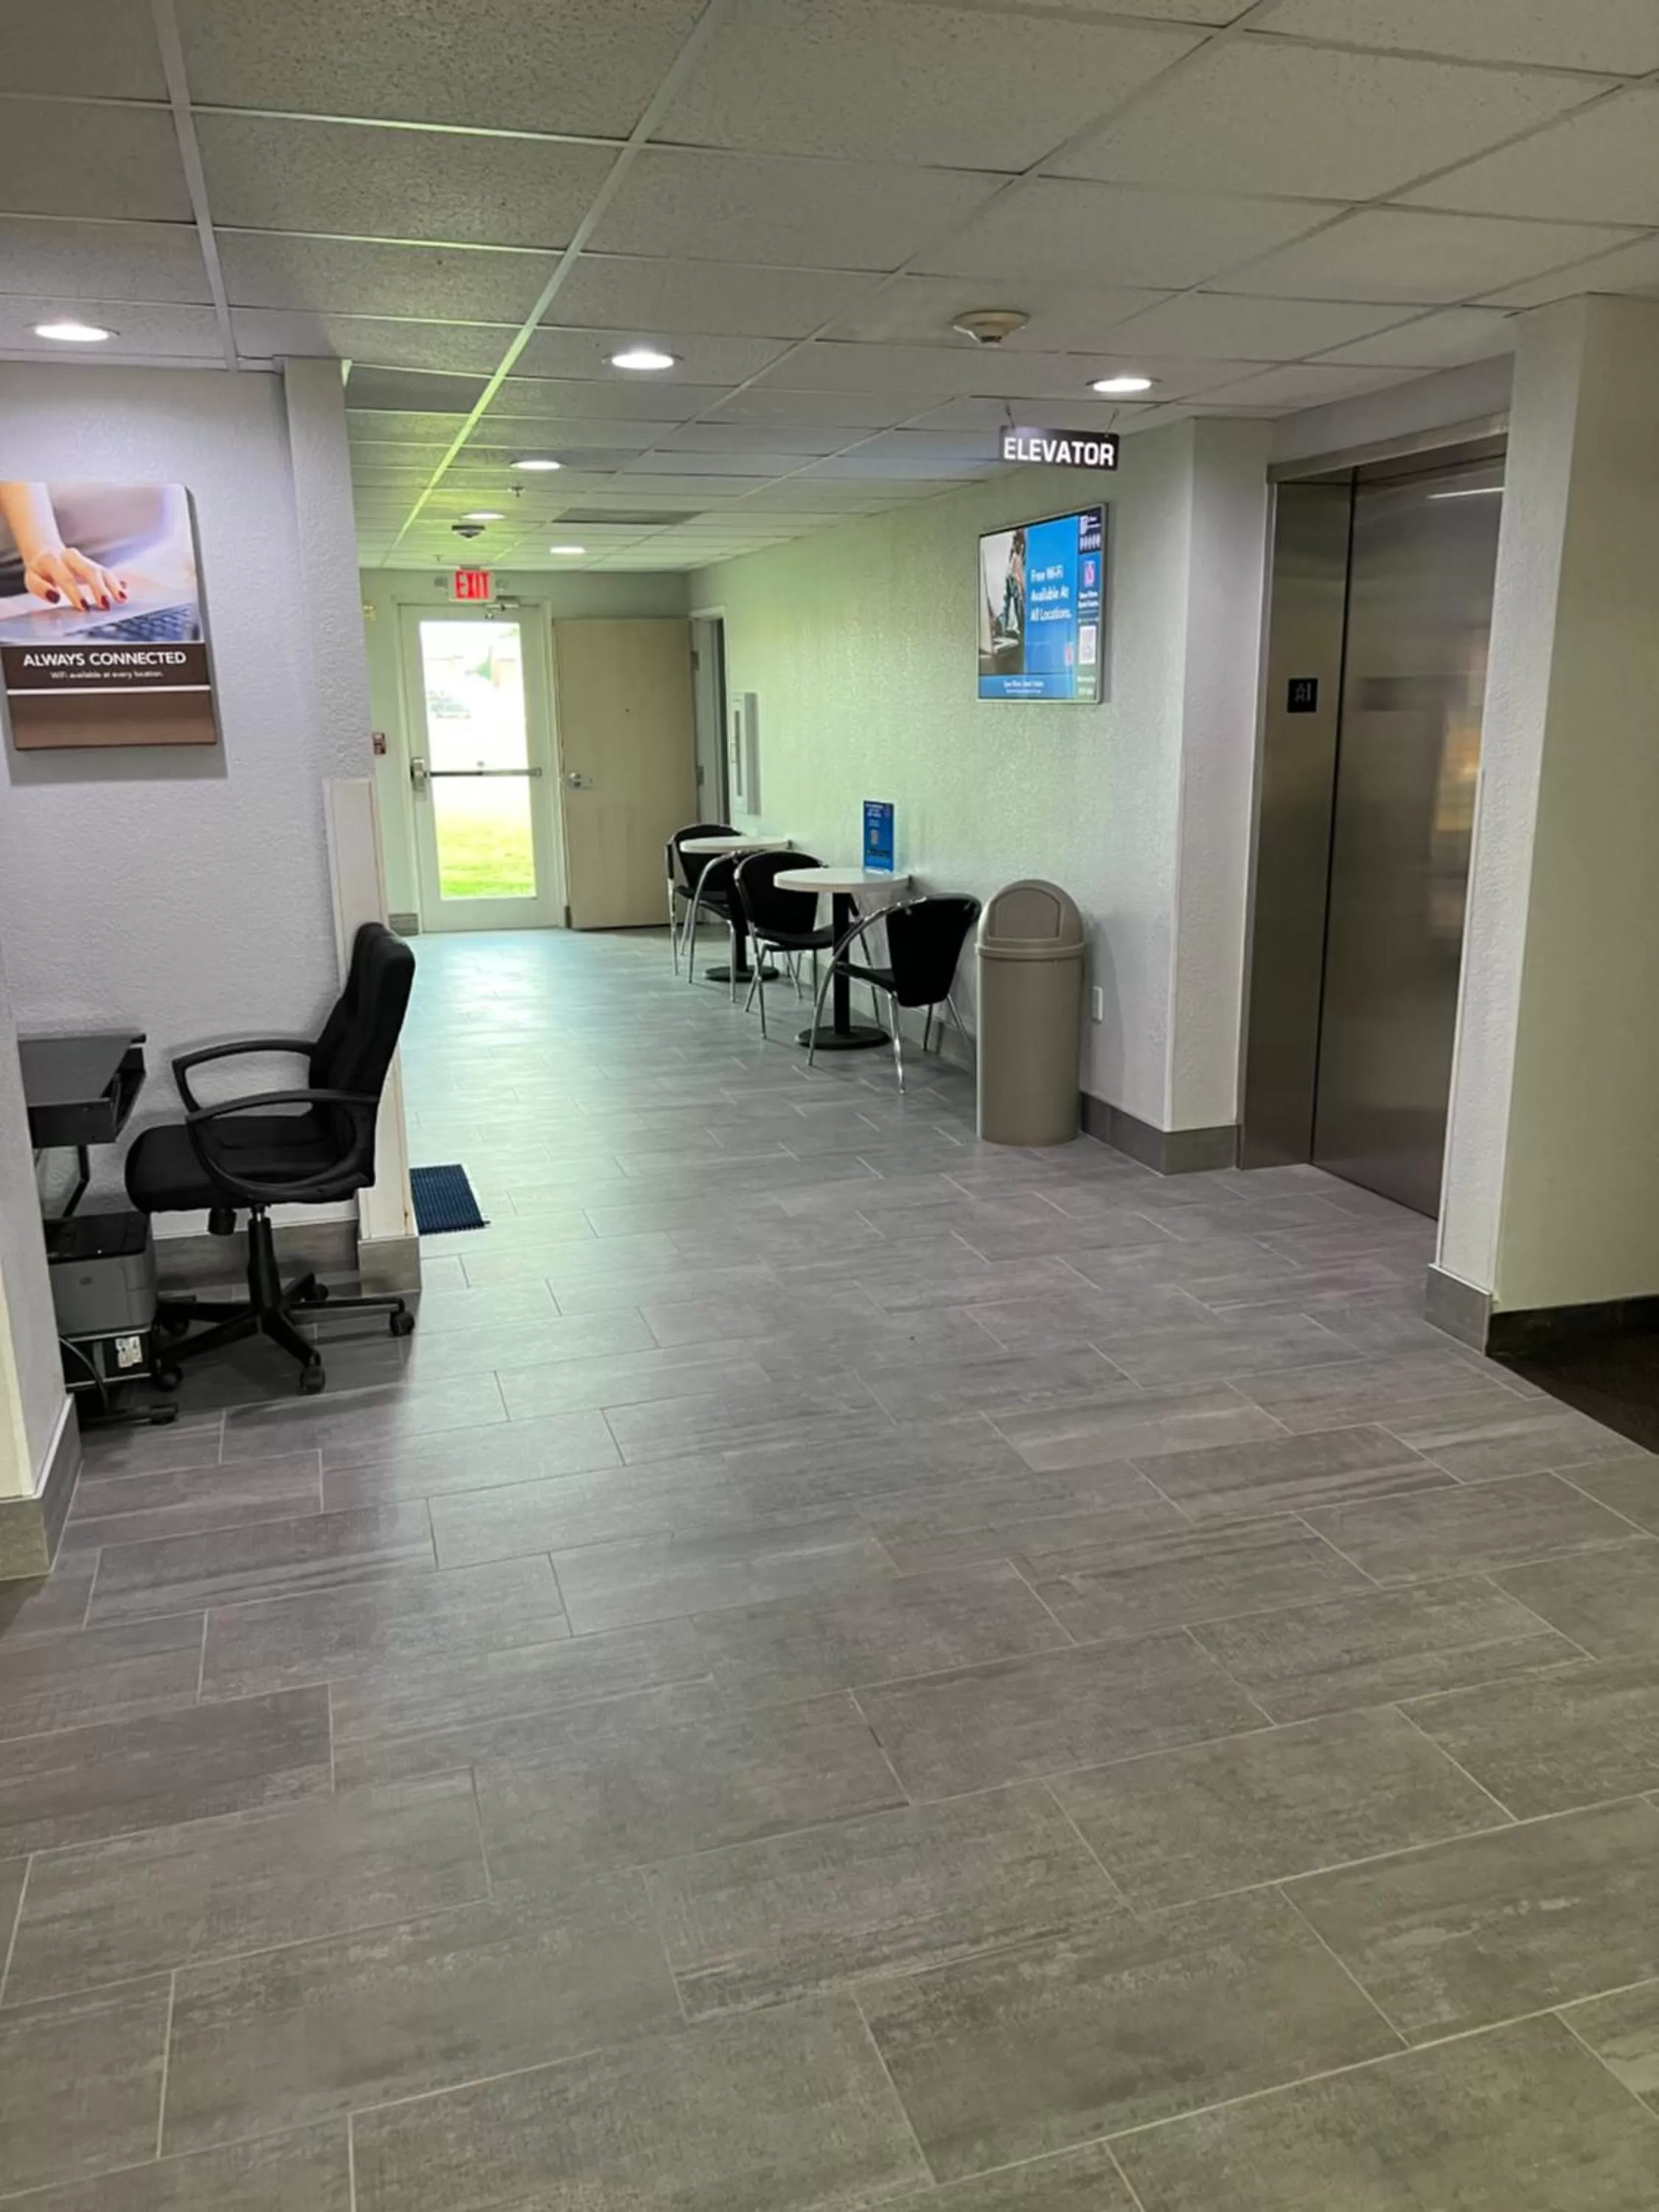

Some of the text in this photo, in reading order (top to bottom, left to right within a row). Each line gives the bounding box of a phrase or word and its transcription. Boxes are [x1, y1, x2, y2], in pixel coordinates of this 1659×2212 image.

[1004, 437, 1114, 466] ELEVATOR
[1031, 568, 1045, 582] Free
[456, 571, 489, 599] EXIT
[1031, 586, 1060, 602] Available
[1030, 608, 1039, 622] All
[24, 651, 187, 667] ALWAYS CONNECTED
[69, 670, 101, 678] available
